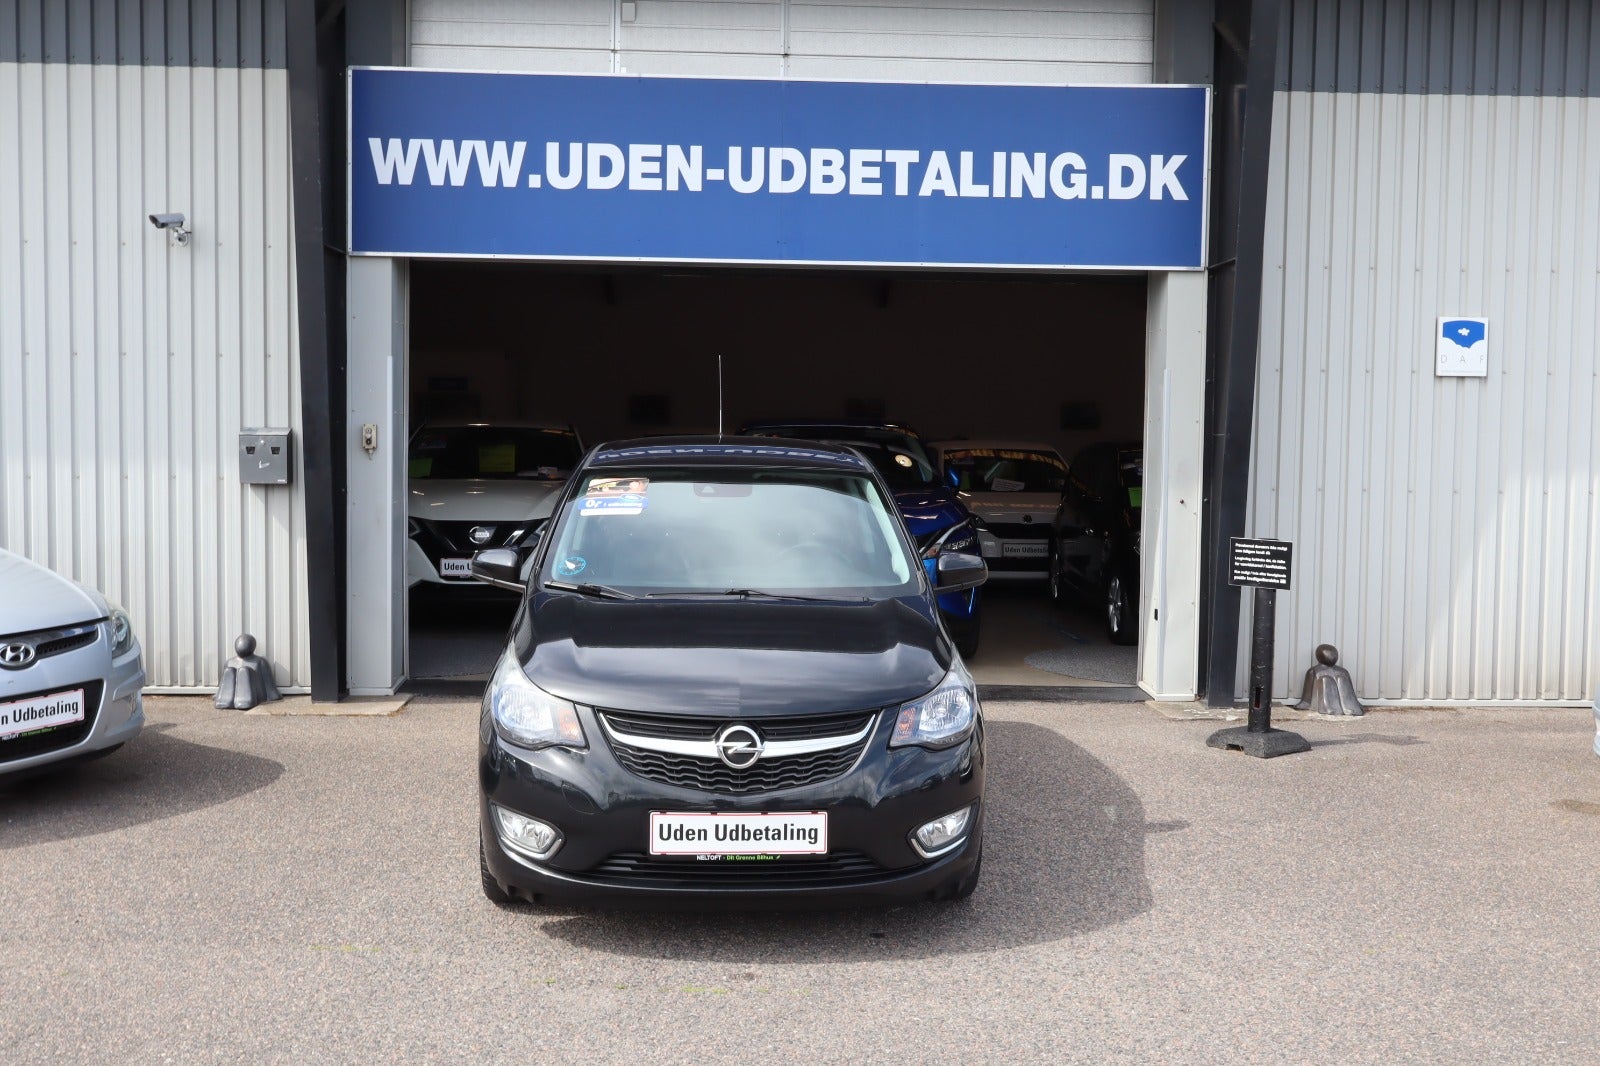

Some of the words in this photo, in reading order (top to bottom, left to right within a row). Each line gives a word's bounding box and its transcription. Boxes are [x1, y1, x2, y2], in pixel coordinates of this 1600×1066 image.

[368, 137, 1190, 201] WWW.UDEN-UDBETALING.DK
[444, 562, 465, 571] Uden
[13, 700, 79, 723] Udbetaling
[658, 823, 708, 841] Uden
[714, 823, 819, 845] Udbetaling
